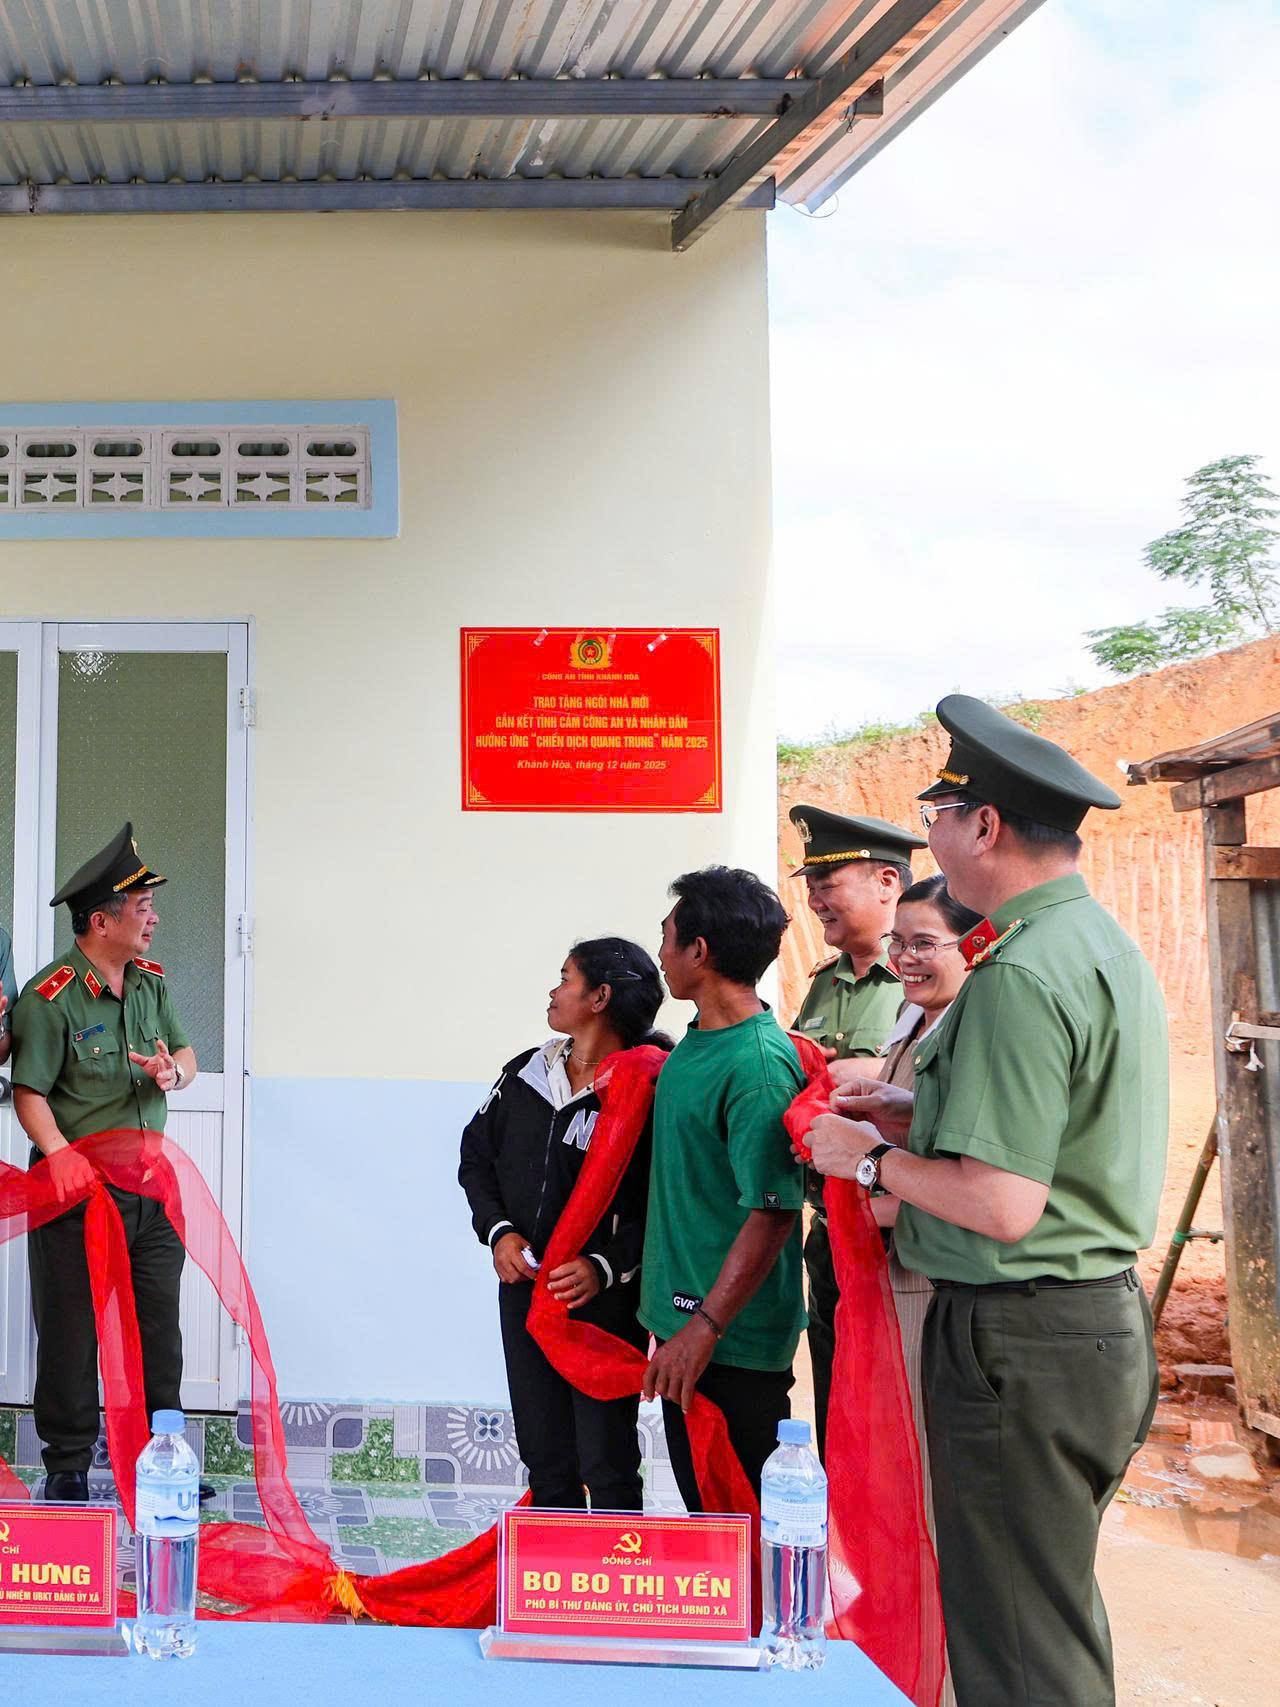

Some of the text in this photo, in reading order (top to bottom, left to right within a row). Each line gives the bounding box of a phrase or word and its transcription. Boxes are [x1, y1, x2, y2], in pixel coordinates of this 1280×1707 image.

[534, 696, 556, 709] TRAO
[517, 712, 534, 728] KẾT
[610, 716, 624, 728] AN
[591, 736, 621, 748] QUANG
[685, 736, 708, 748] 2025
[517, 760, 549, 769] Khánh
[607, 761, 618, 769] 12
[643, 760, 667, 769] 2025
[673, 1296, 696, 1310] GVR
[2, 1545, 20, 1555] CHÍ
[602, 1554, 652, 1566] ĐỒNG CHÍ
[12, 1562, 91, 1585] HƯNG
[523, 1570, 732, 1601] BO BO THỊ YẾN
[32, 1591, 52, 1601] UBKT
[525, 1597, 546, 1610] PHÓ
[549, 1598, 559, 1610] BÍ
[562, 1600, 582, 1611] THƯ
[584, 1599, 612, 1612] ĐẢNG
[632, 1600, 653, 1613] CHỦ
[656, 1603, 679, 1616] TỊCH
[682, 1605, 710, 1615] UBND
[713, 1604, 727, 1616] XÃ
